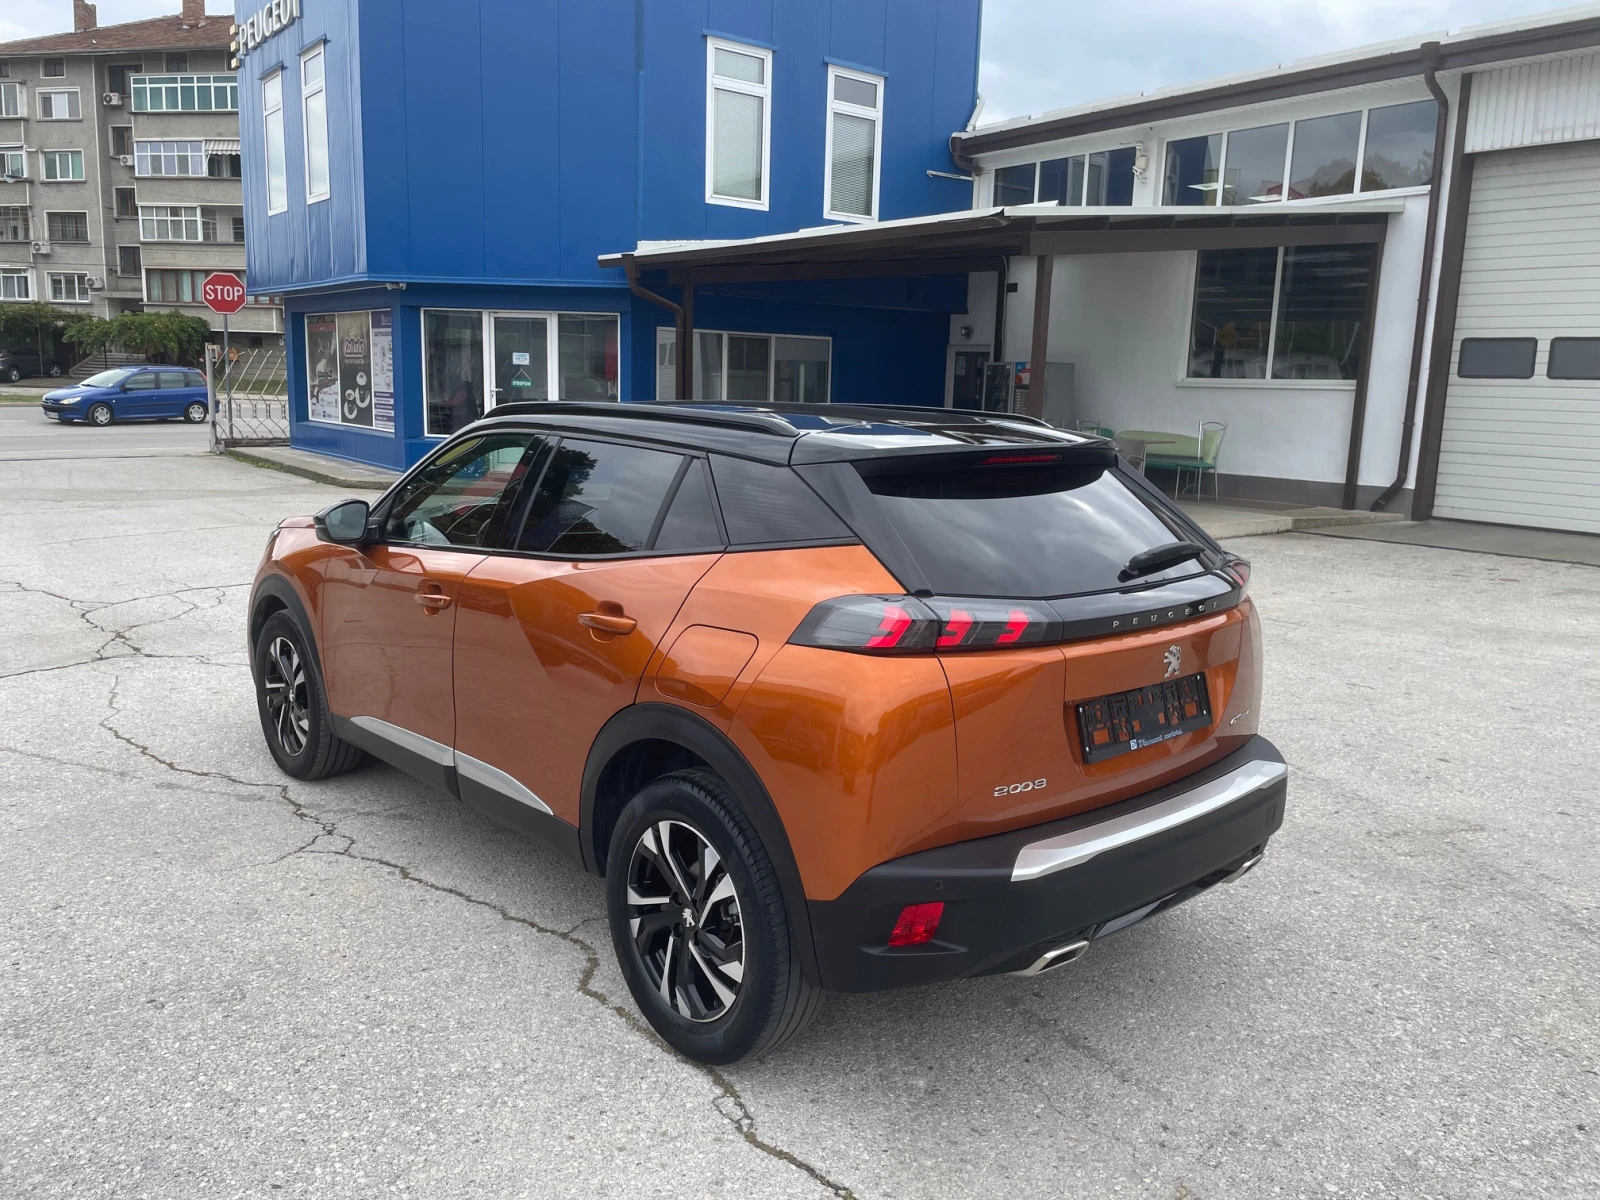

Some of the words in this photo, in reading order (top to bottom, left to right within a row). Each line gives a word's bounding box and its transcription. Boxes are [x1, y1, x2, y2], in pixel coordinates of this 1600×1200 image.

[205, 285, 243, 301] STOP
[1112, 601, 1218, 629] PEUGEOT
[993, 778, 1047, 797] 2008
